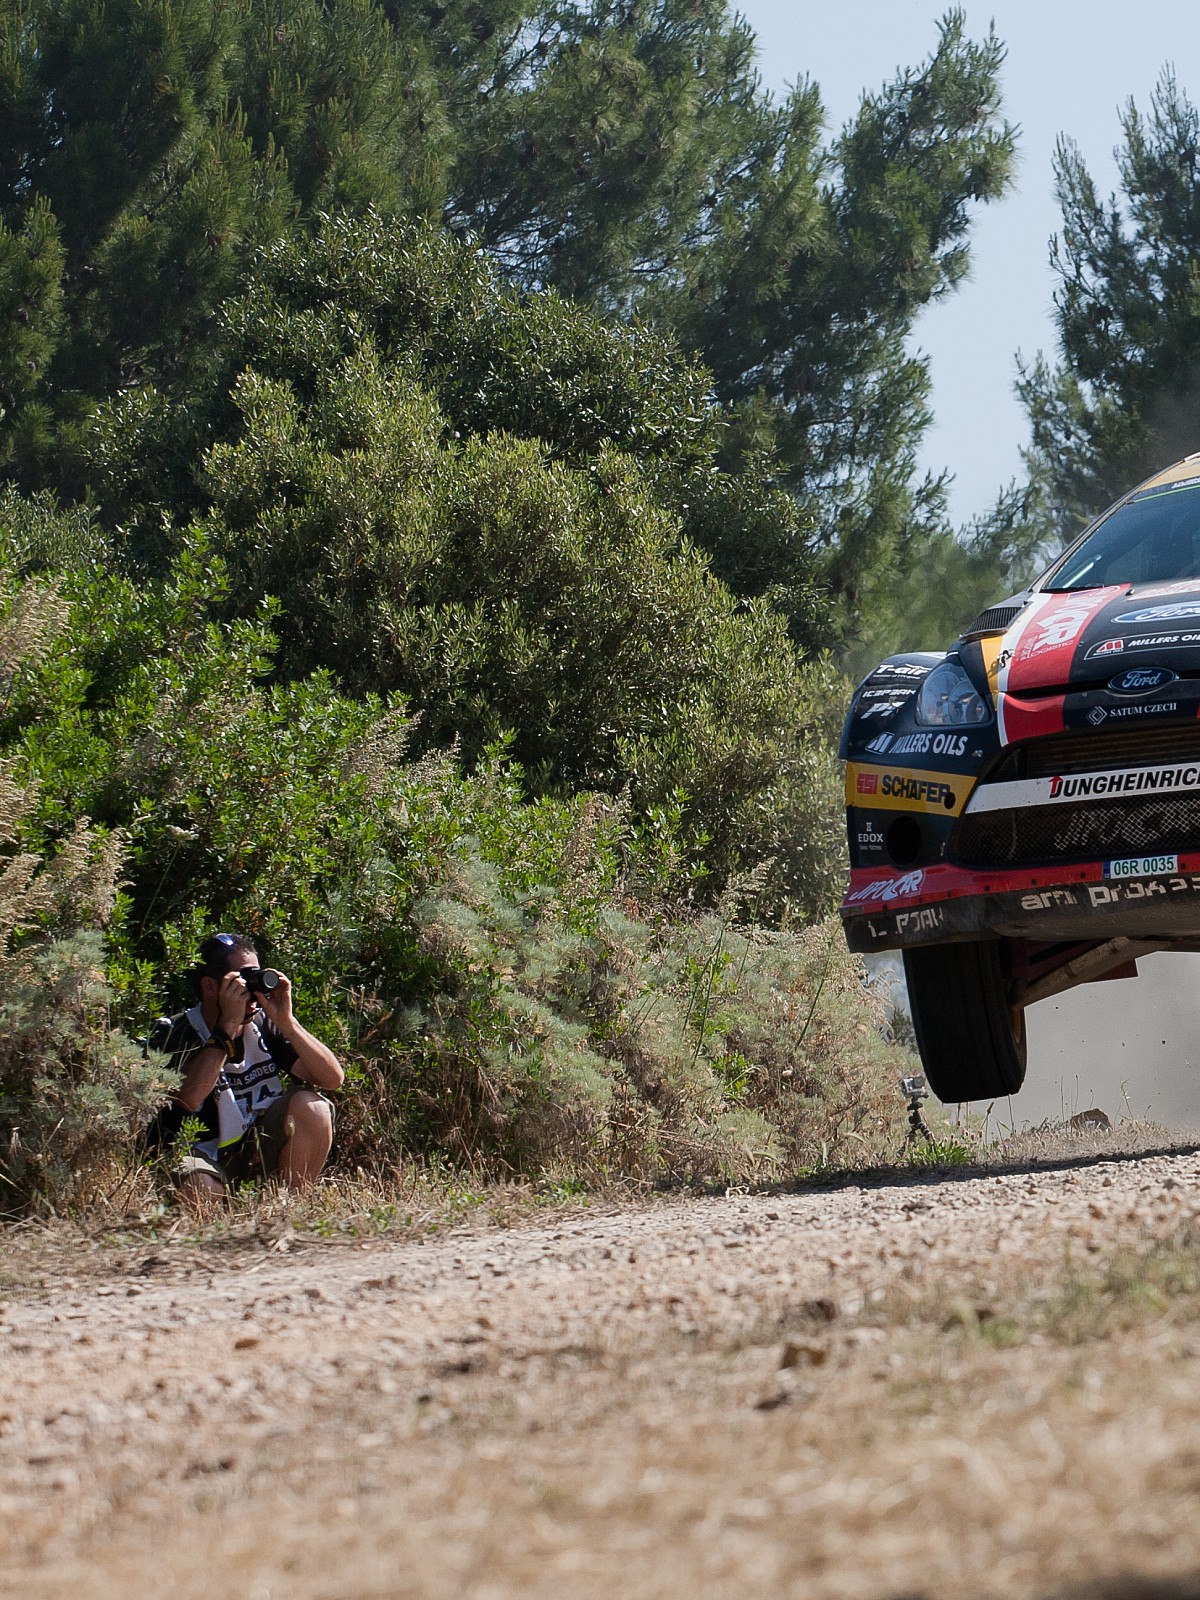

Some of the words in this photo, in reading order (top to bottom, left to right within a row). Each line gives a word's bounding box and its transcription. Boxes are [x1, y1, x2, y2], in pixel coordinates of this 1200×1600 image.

[1128, 635, 1179, 648] MILLERS
[1121, 668, 1161, 689] Ford
[1110, 705, 1142, 717] SATUM
[1144, 703, 1177, 714] CZECH
[888, 733, 933, 753] MILLERS
[932, 733, 968, 756] OILS
[858, 833, 884, 843] EDOX
[1113, 859, 1139, 876] 06R
[1142, 856, 1175, 873] 0035
